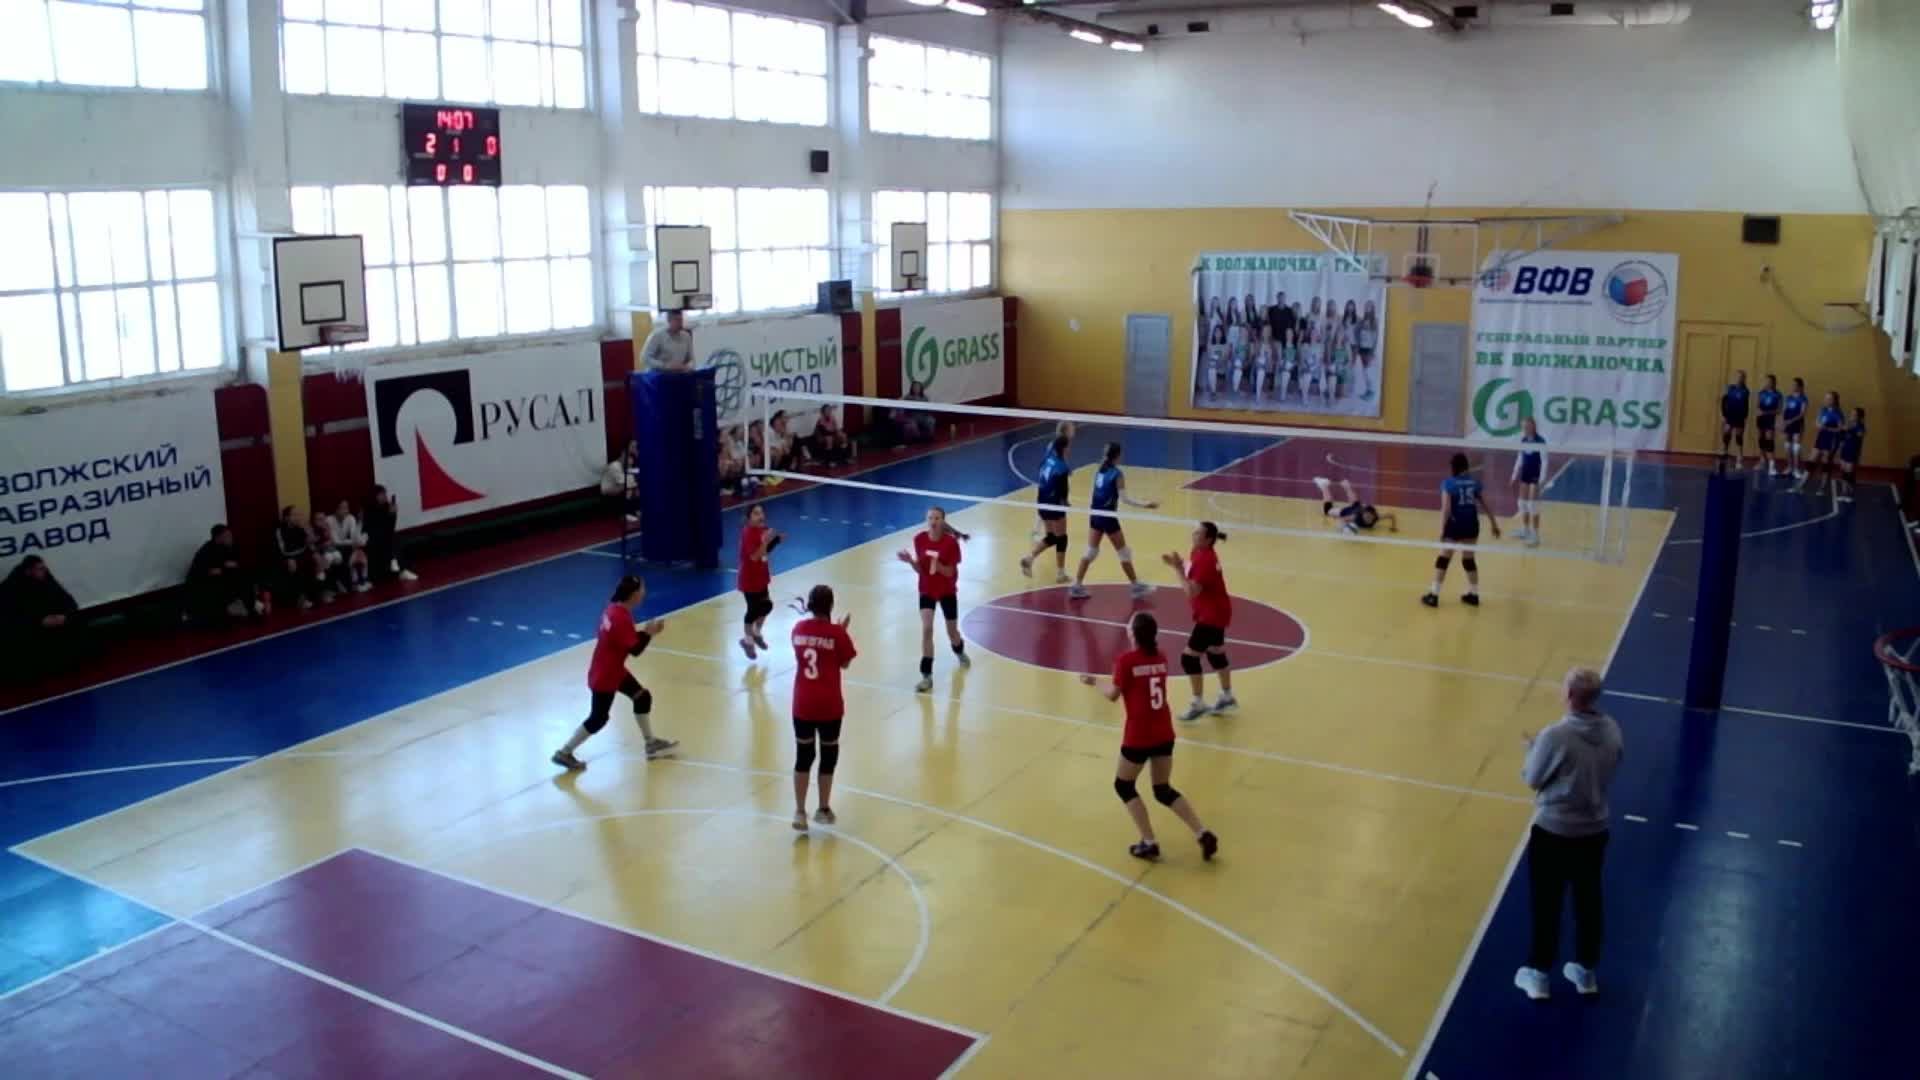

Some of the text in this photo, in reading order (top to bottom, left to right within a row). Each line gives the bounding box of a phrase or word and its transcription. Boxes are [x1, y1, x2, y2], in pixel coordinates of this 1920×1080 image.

[425, 133, 436, 154] 2
[453, 138, 459, 152] 1
[486, 136, 497, 155] 0
[436, 164, 446, 181] 0
[463, 164, 473, 181] 0
[1215, 256, 1317, 272] ВОЛЖАНОЧКА
[1512, 265, 1594, 296] ВФВ
[943, 331, 1000, 368] GRASS
[1476, 331, 1668, 349] ГЕНЕРАЛЬНЫЙ ПАРТНЕР
[750, 336, 837, 376] ЧИСТЫЙ
[1475, 351, 1665, 374] ВК ВОЛЖАНОЧКА
[480, 387, 595, 440] РУСАЛ
[1543, 396, 1662, 431] GRASS
[0, 443, 178, 496] ВОЛЖСКИЙ
[0, 465, 212, 525] АБРАЗИВНЫЙ
[0, 517, 110, 557] ЗАВОД
[925, 549, 939, 575] 7
[803, 647, 818, 680] 3
[1149, 676, 1163, 711] 5
